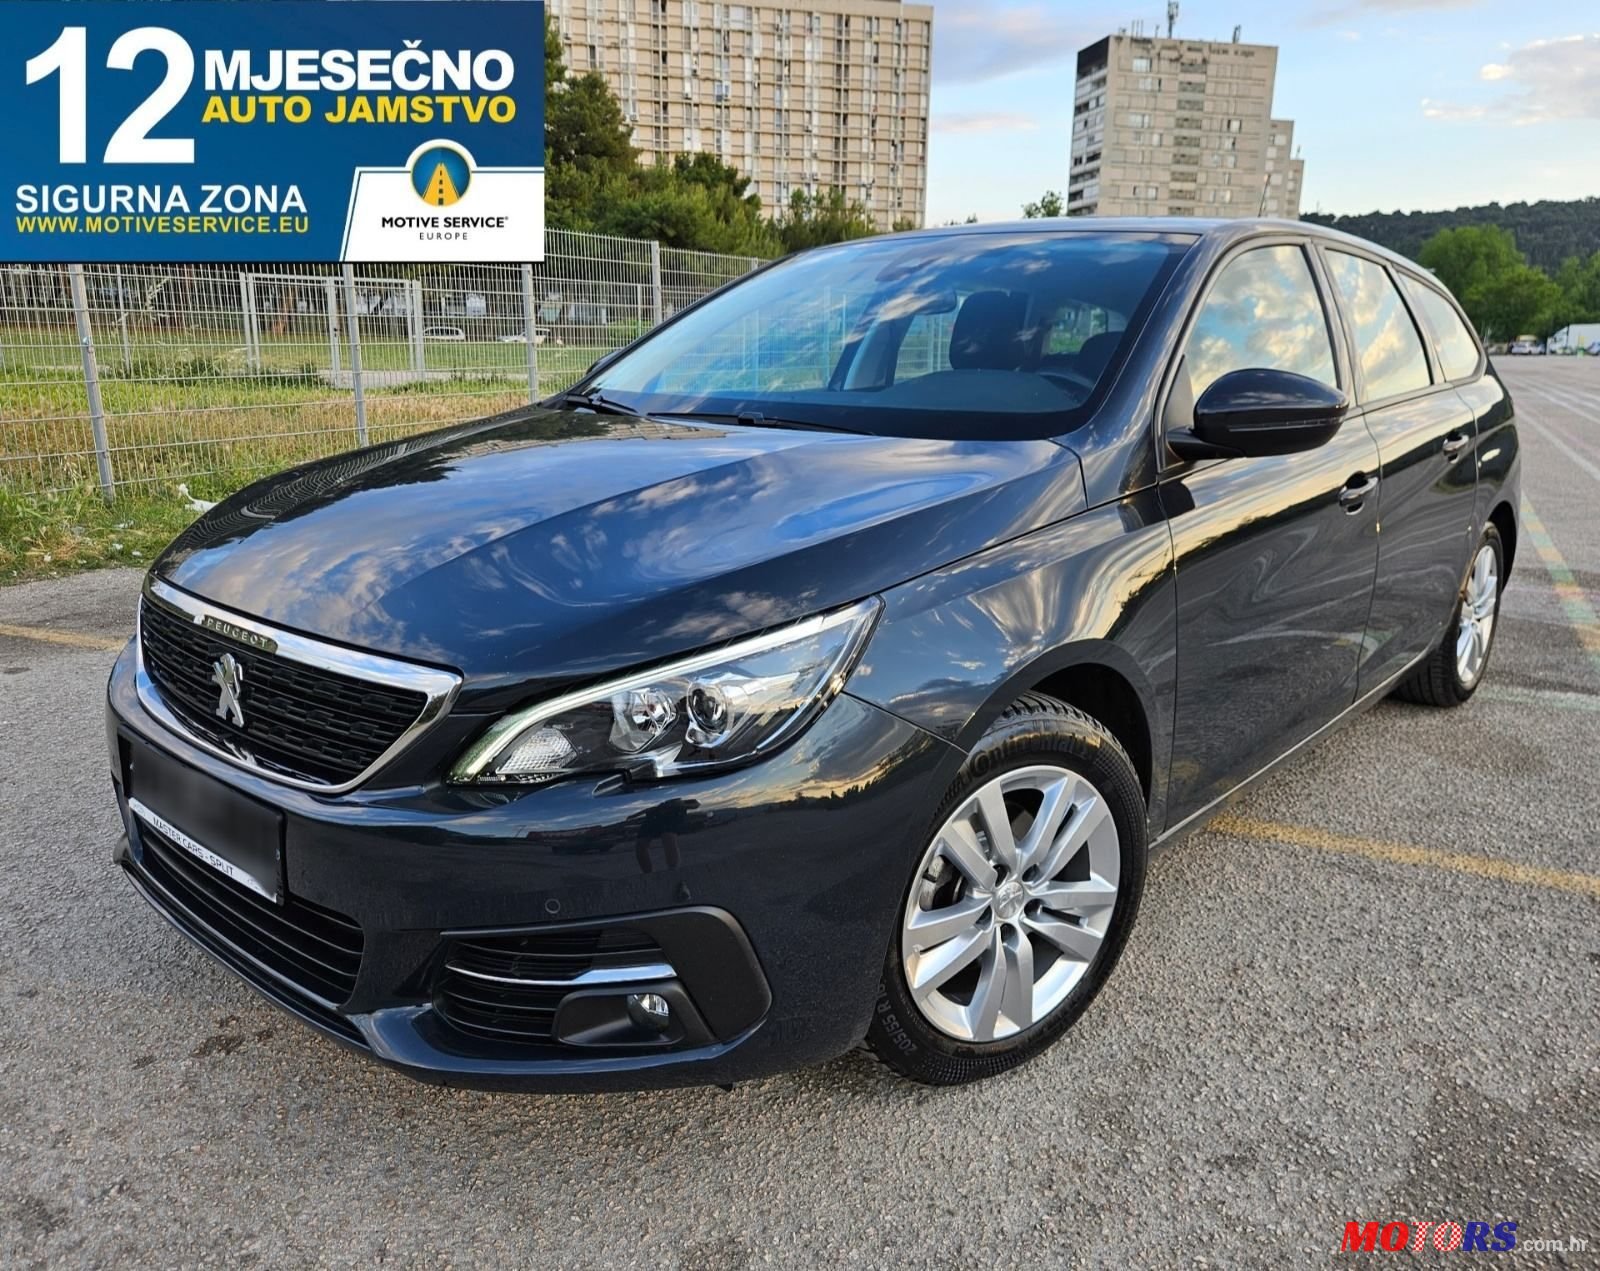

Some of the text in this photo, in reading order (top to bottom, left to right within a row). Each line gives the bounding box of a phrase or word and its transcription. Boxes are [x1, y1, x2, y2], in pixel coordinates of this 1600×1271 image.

[206, 617, 268, 648] PEUGEOT
[152, 816, 182, 846] MASTER
[182, 838, 205, 860] CARS
[209, 855, 235, 877] SPLIT
[877, 999, 892, 1014] R
[882, 1013, 918, 1056] 205/55
